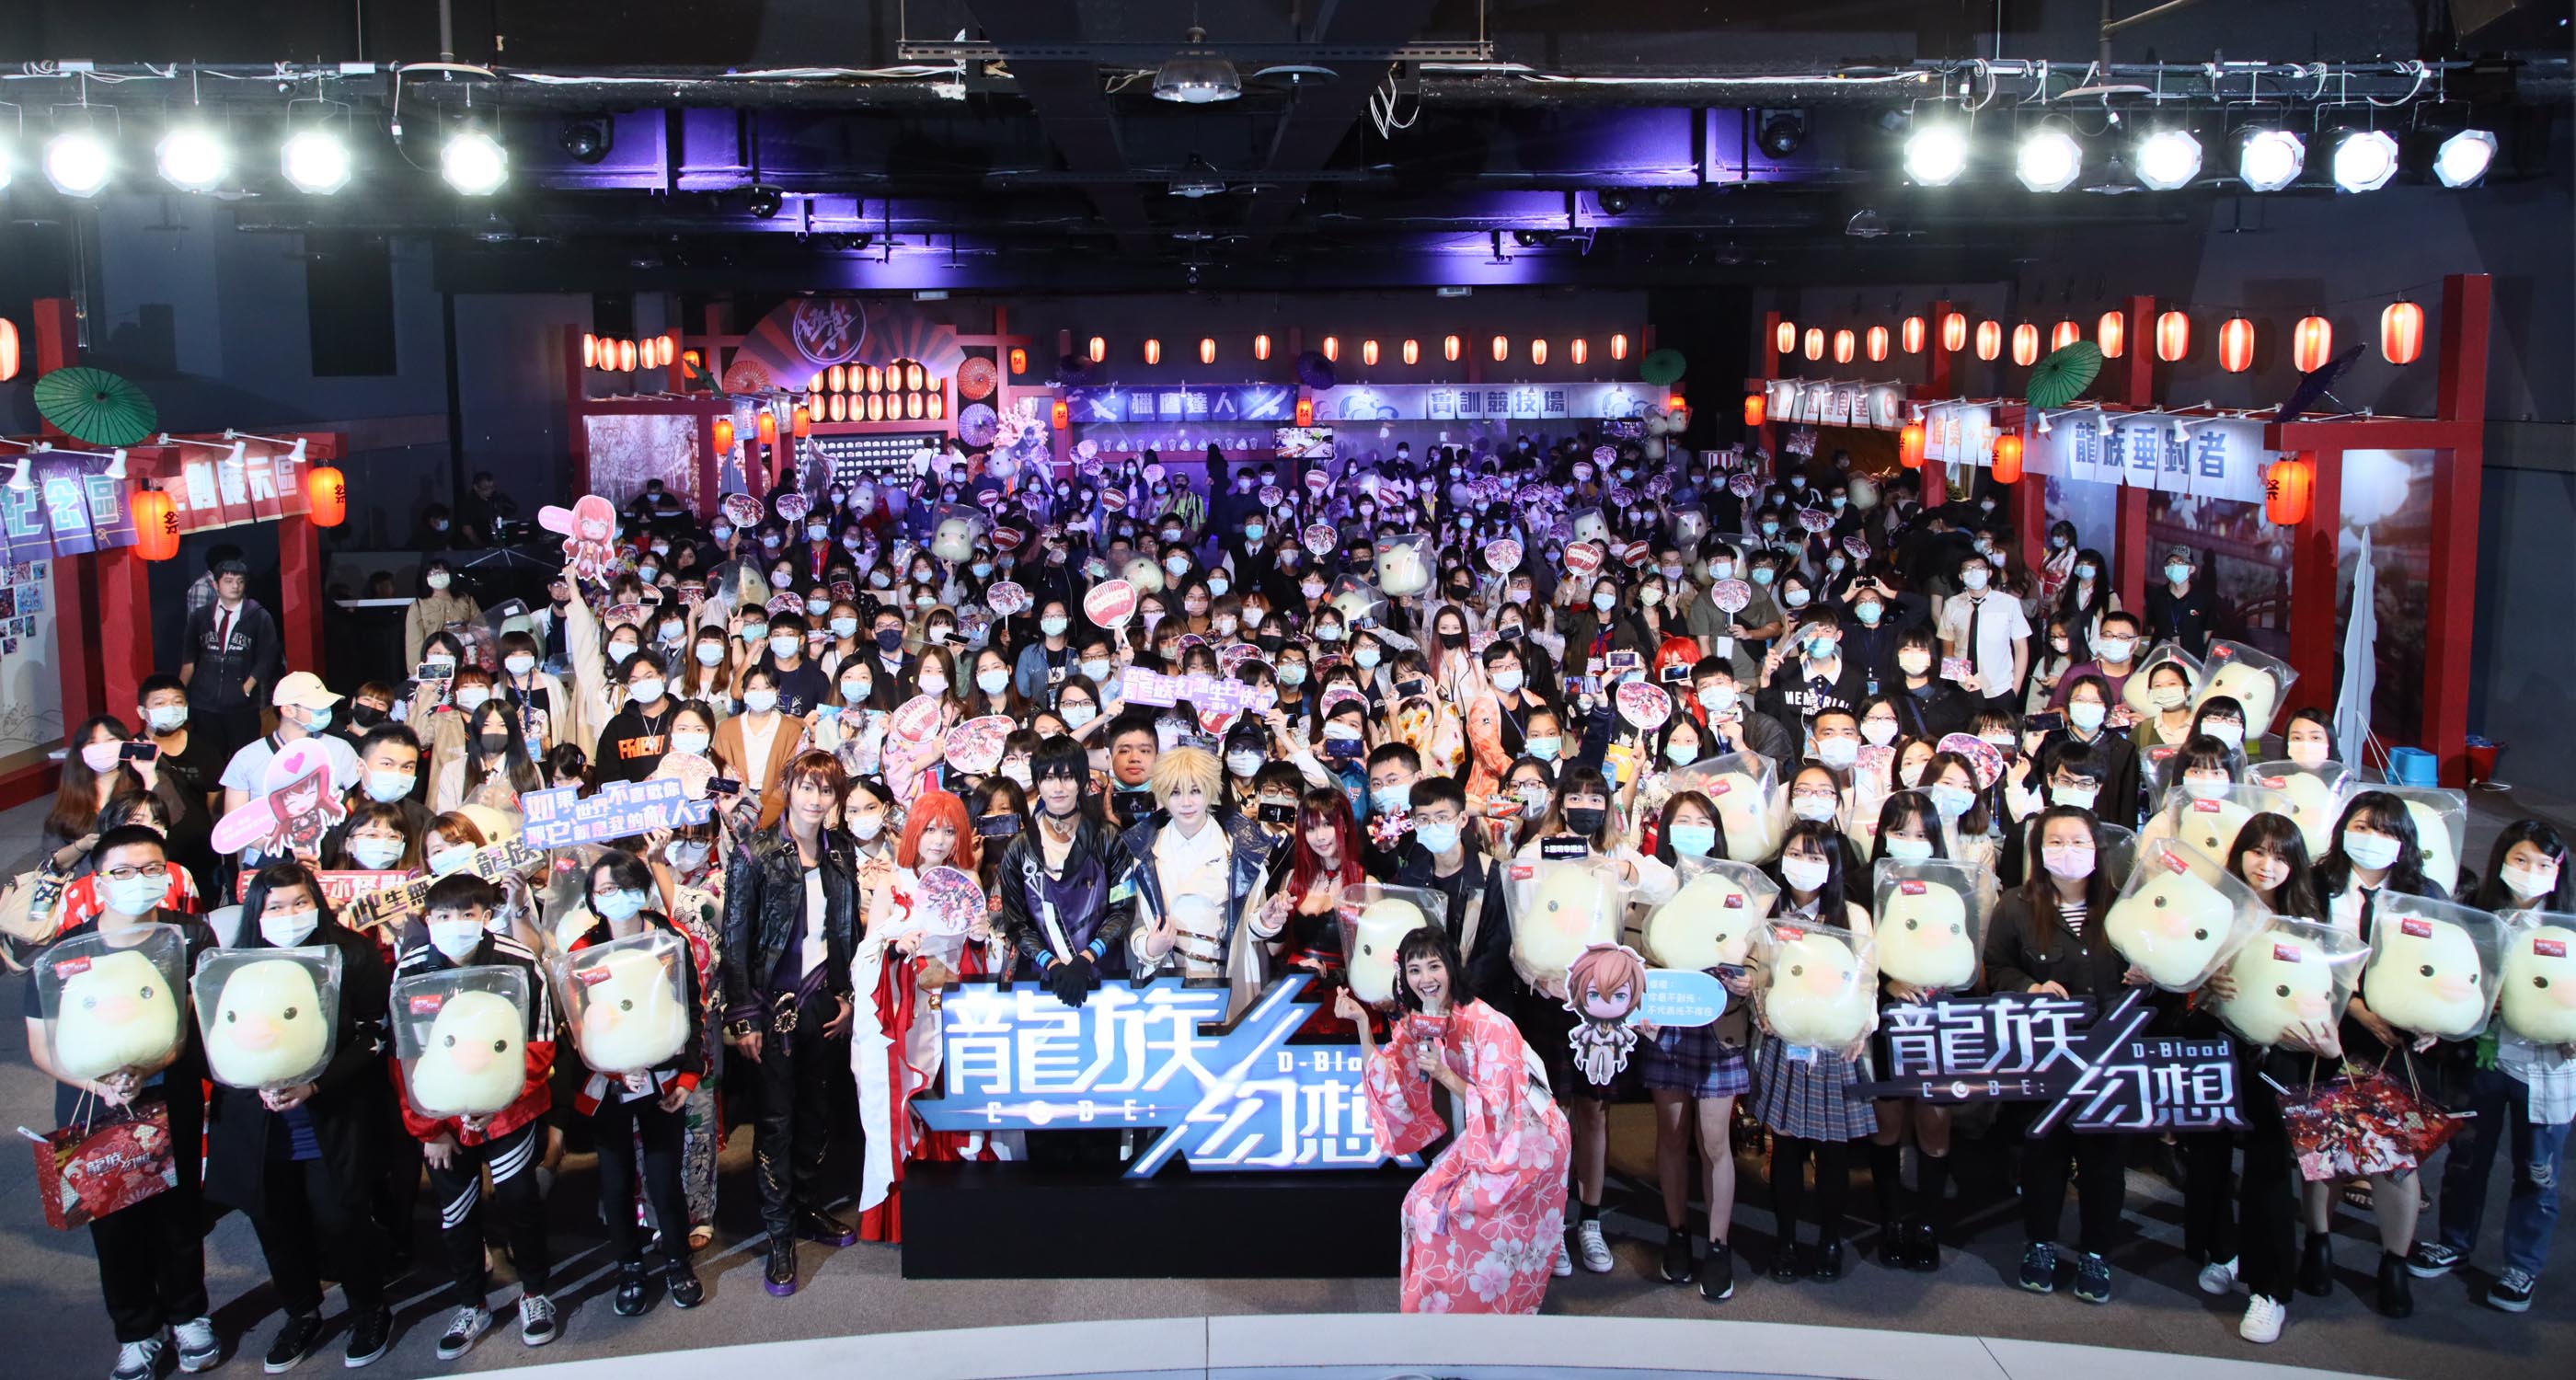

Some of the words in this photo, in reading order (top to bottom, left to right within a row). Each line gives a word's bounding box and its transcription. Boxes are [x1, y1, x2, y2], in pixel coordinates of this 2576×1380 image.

[1132, 391, 1236, 414] 獵鷹達人
[1431, 389, 1566, 413] 實訓競技場
[2075, 420, 2226, 479] 龍族垂釣者
[177, 454, 297, 511] 創展示區
[0, 473, 121, 538] 紀念區
[1785, 691, 1849, 709] MEMRIAL
[617, 734, 665, 760] FRIEN
[2132, 1041, 2229, 1058] D-Blood
[1277, 1051, 1363, 1073] D-Blo
